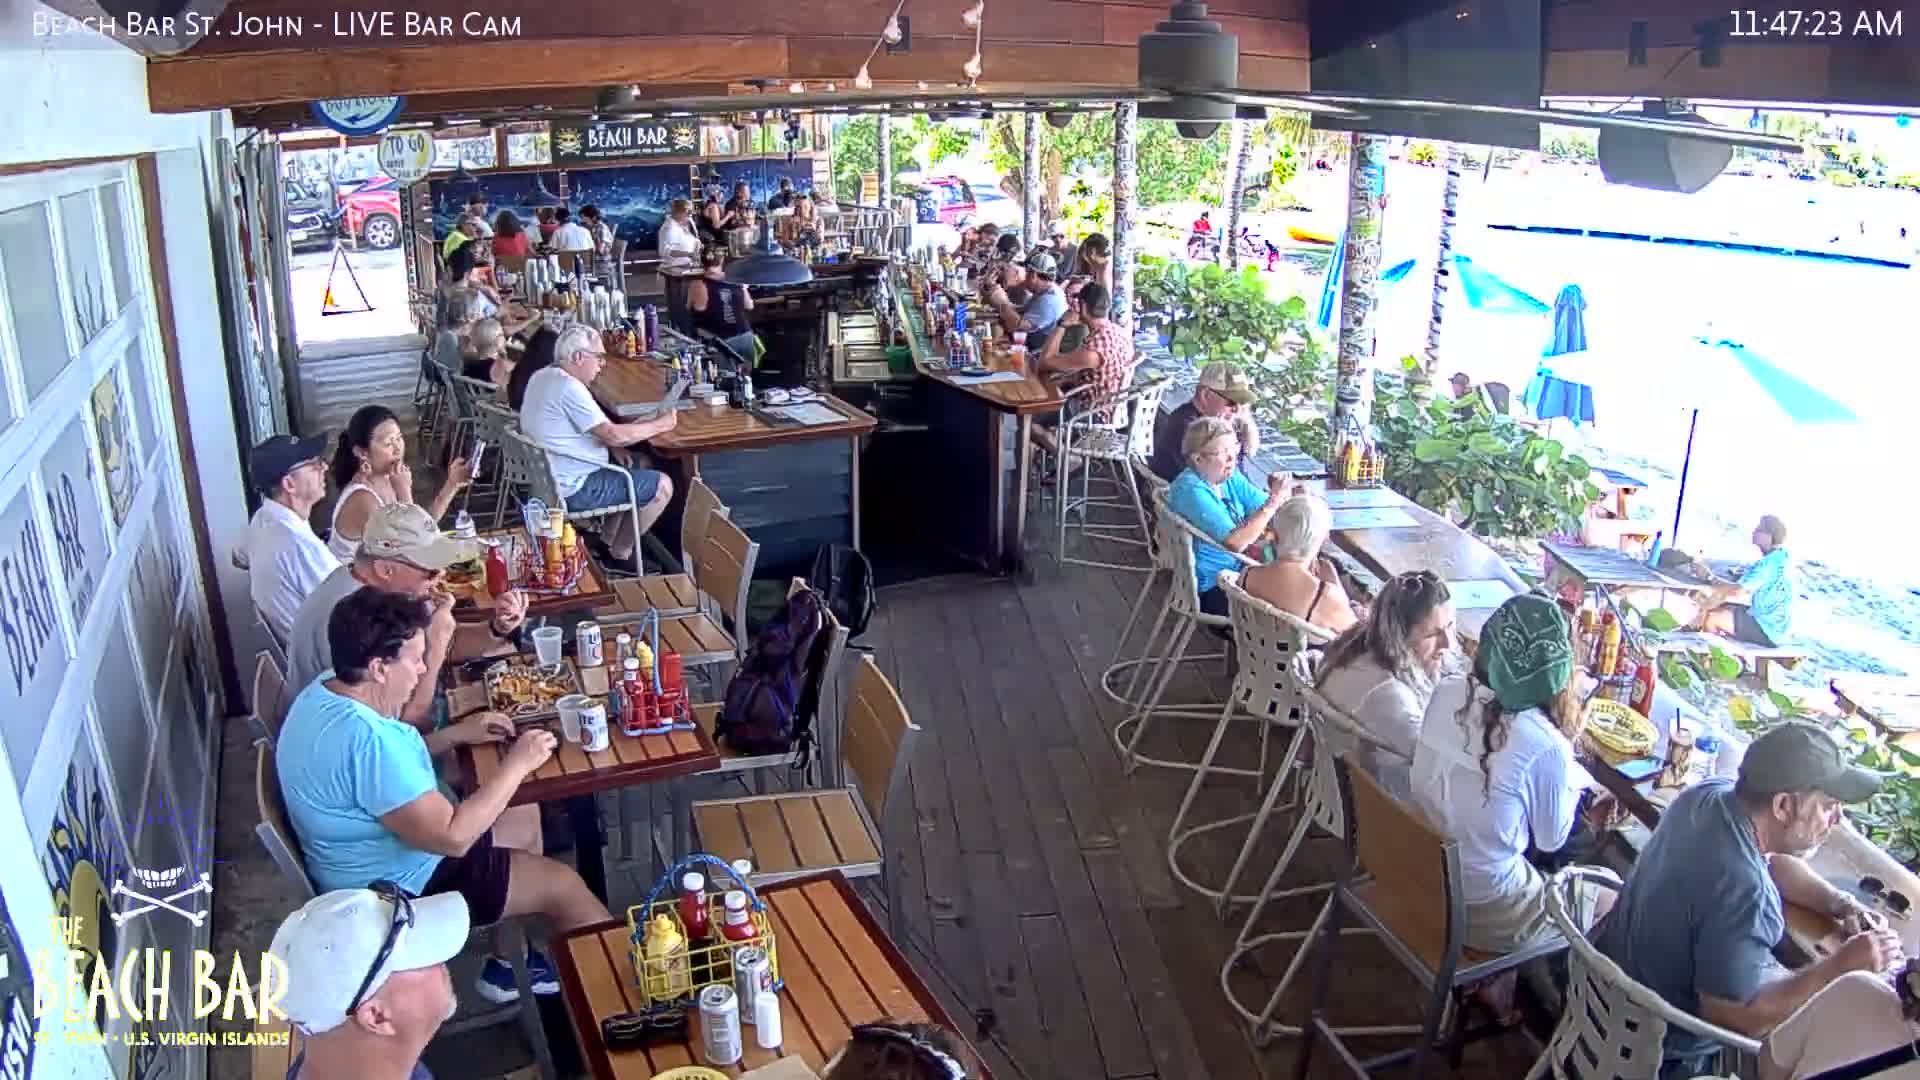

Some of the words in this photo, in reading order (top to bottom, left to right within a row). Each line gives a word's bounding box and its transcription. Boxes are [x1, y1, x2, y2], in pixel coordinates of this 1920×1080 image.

[386, 135, 404, 156] TO
[408, 134, 425, 153] GO
[588, 127, 632, 148] BEACH
[637, 127, 668, 145] BAR
